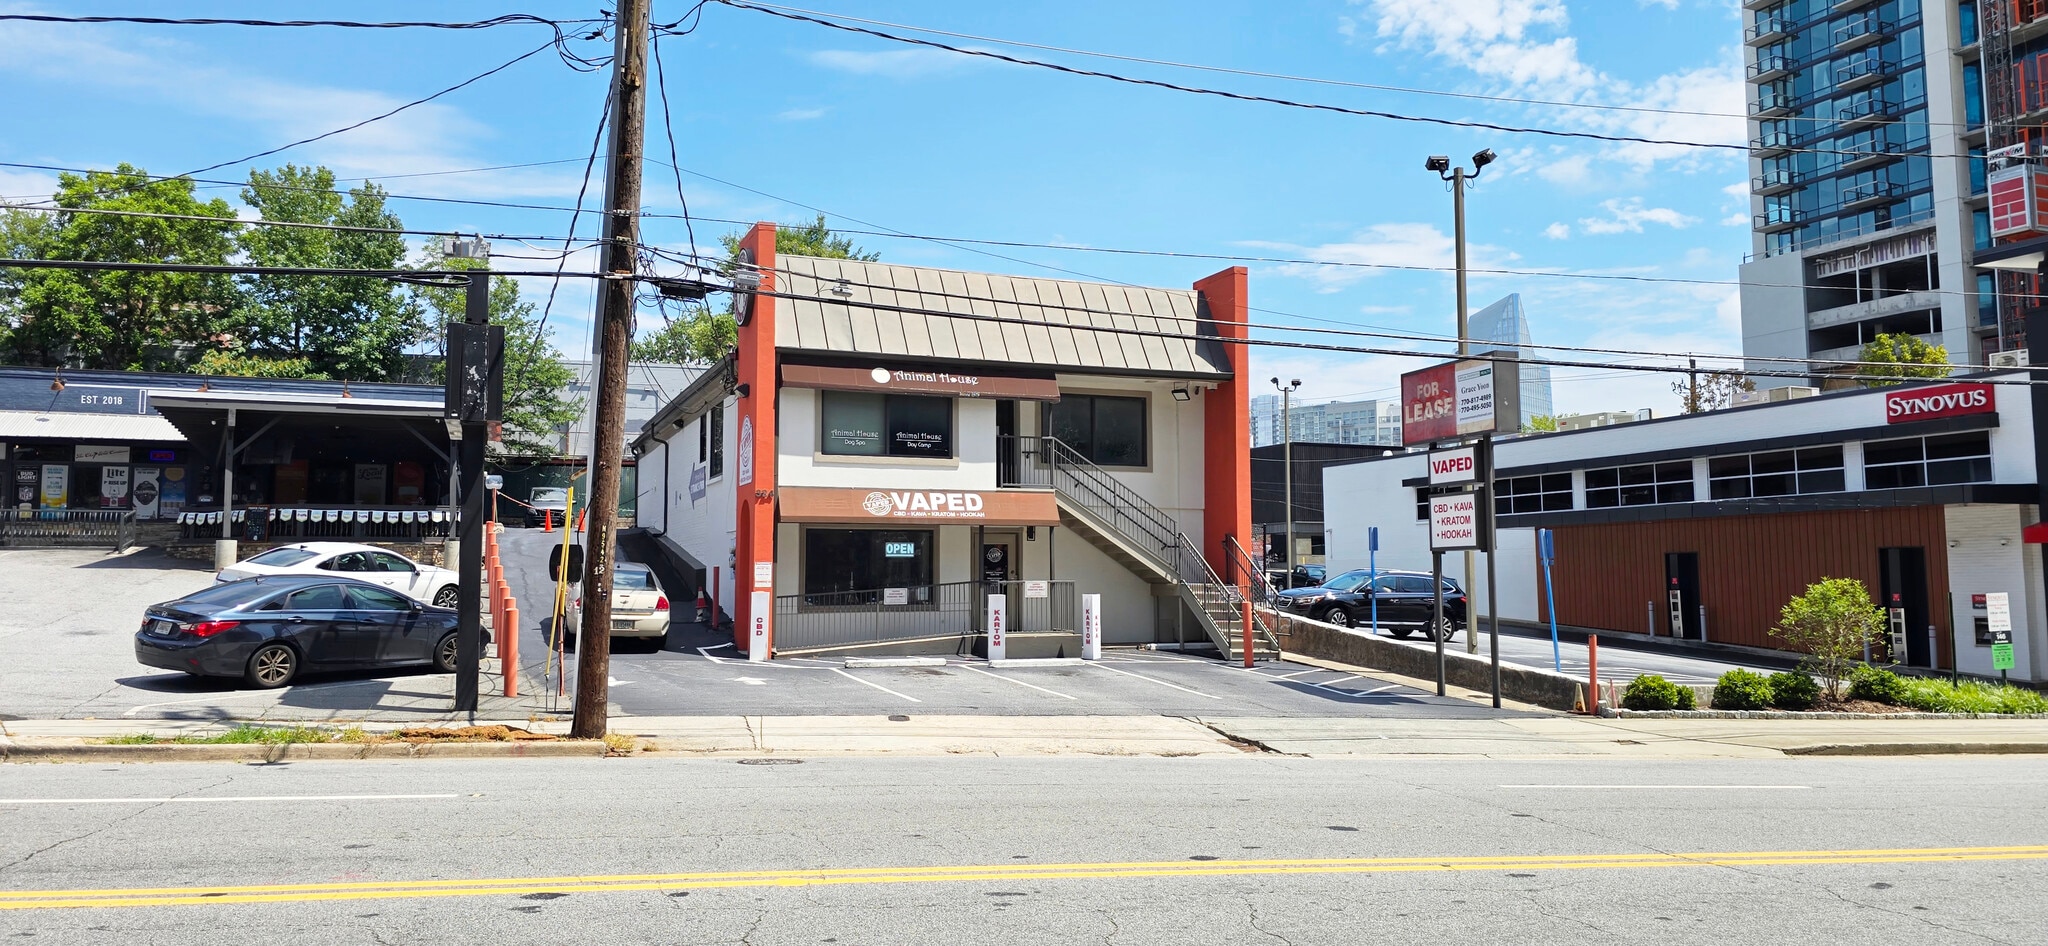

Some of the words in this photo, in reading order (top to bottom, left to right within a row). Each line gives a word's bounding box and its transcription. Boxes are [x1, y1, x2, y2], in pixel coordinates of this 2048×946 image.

[893, 370, 937, 382] Animal
[939, 372, 979, 386] House
[1416, 382, 1440, 399] FOR
[80, 395, 98, 404] EST
[102, 396, 122, 405] 2018
[1888, 390, 1988, 417] SYNOVUS
[1404, 396, 1454, 424] LEASE
[106, 468, 125, 478] Lite
[1432, 456, 1472, 474] VAPED
[890, 492, 983, 511] VAPED
[1434, 504, 1448, 513] CBD
[1454, 502, 1474, 512] KAVA
[1442, 516, 1470, 526] KRATOM
[1442, 530, 1472, 540] HOOKAH
[886, 543, 914, 554] OPEN
[756, 618, 764, 636] CBD
[993, 610, 1001, 646] KARTOM
